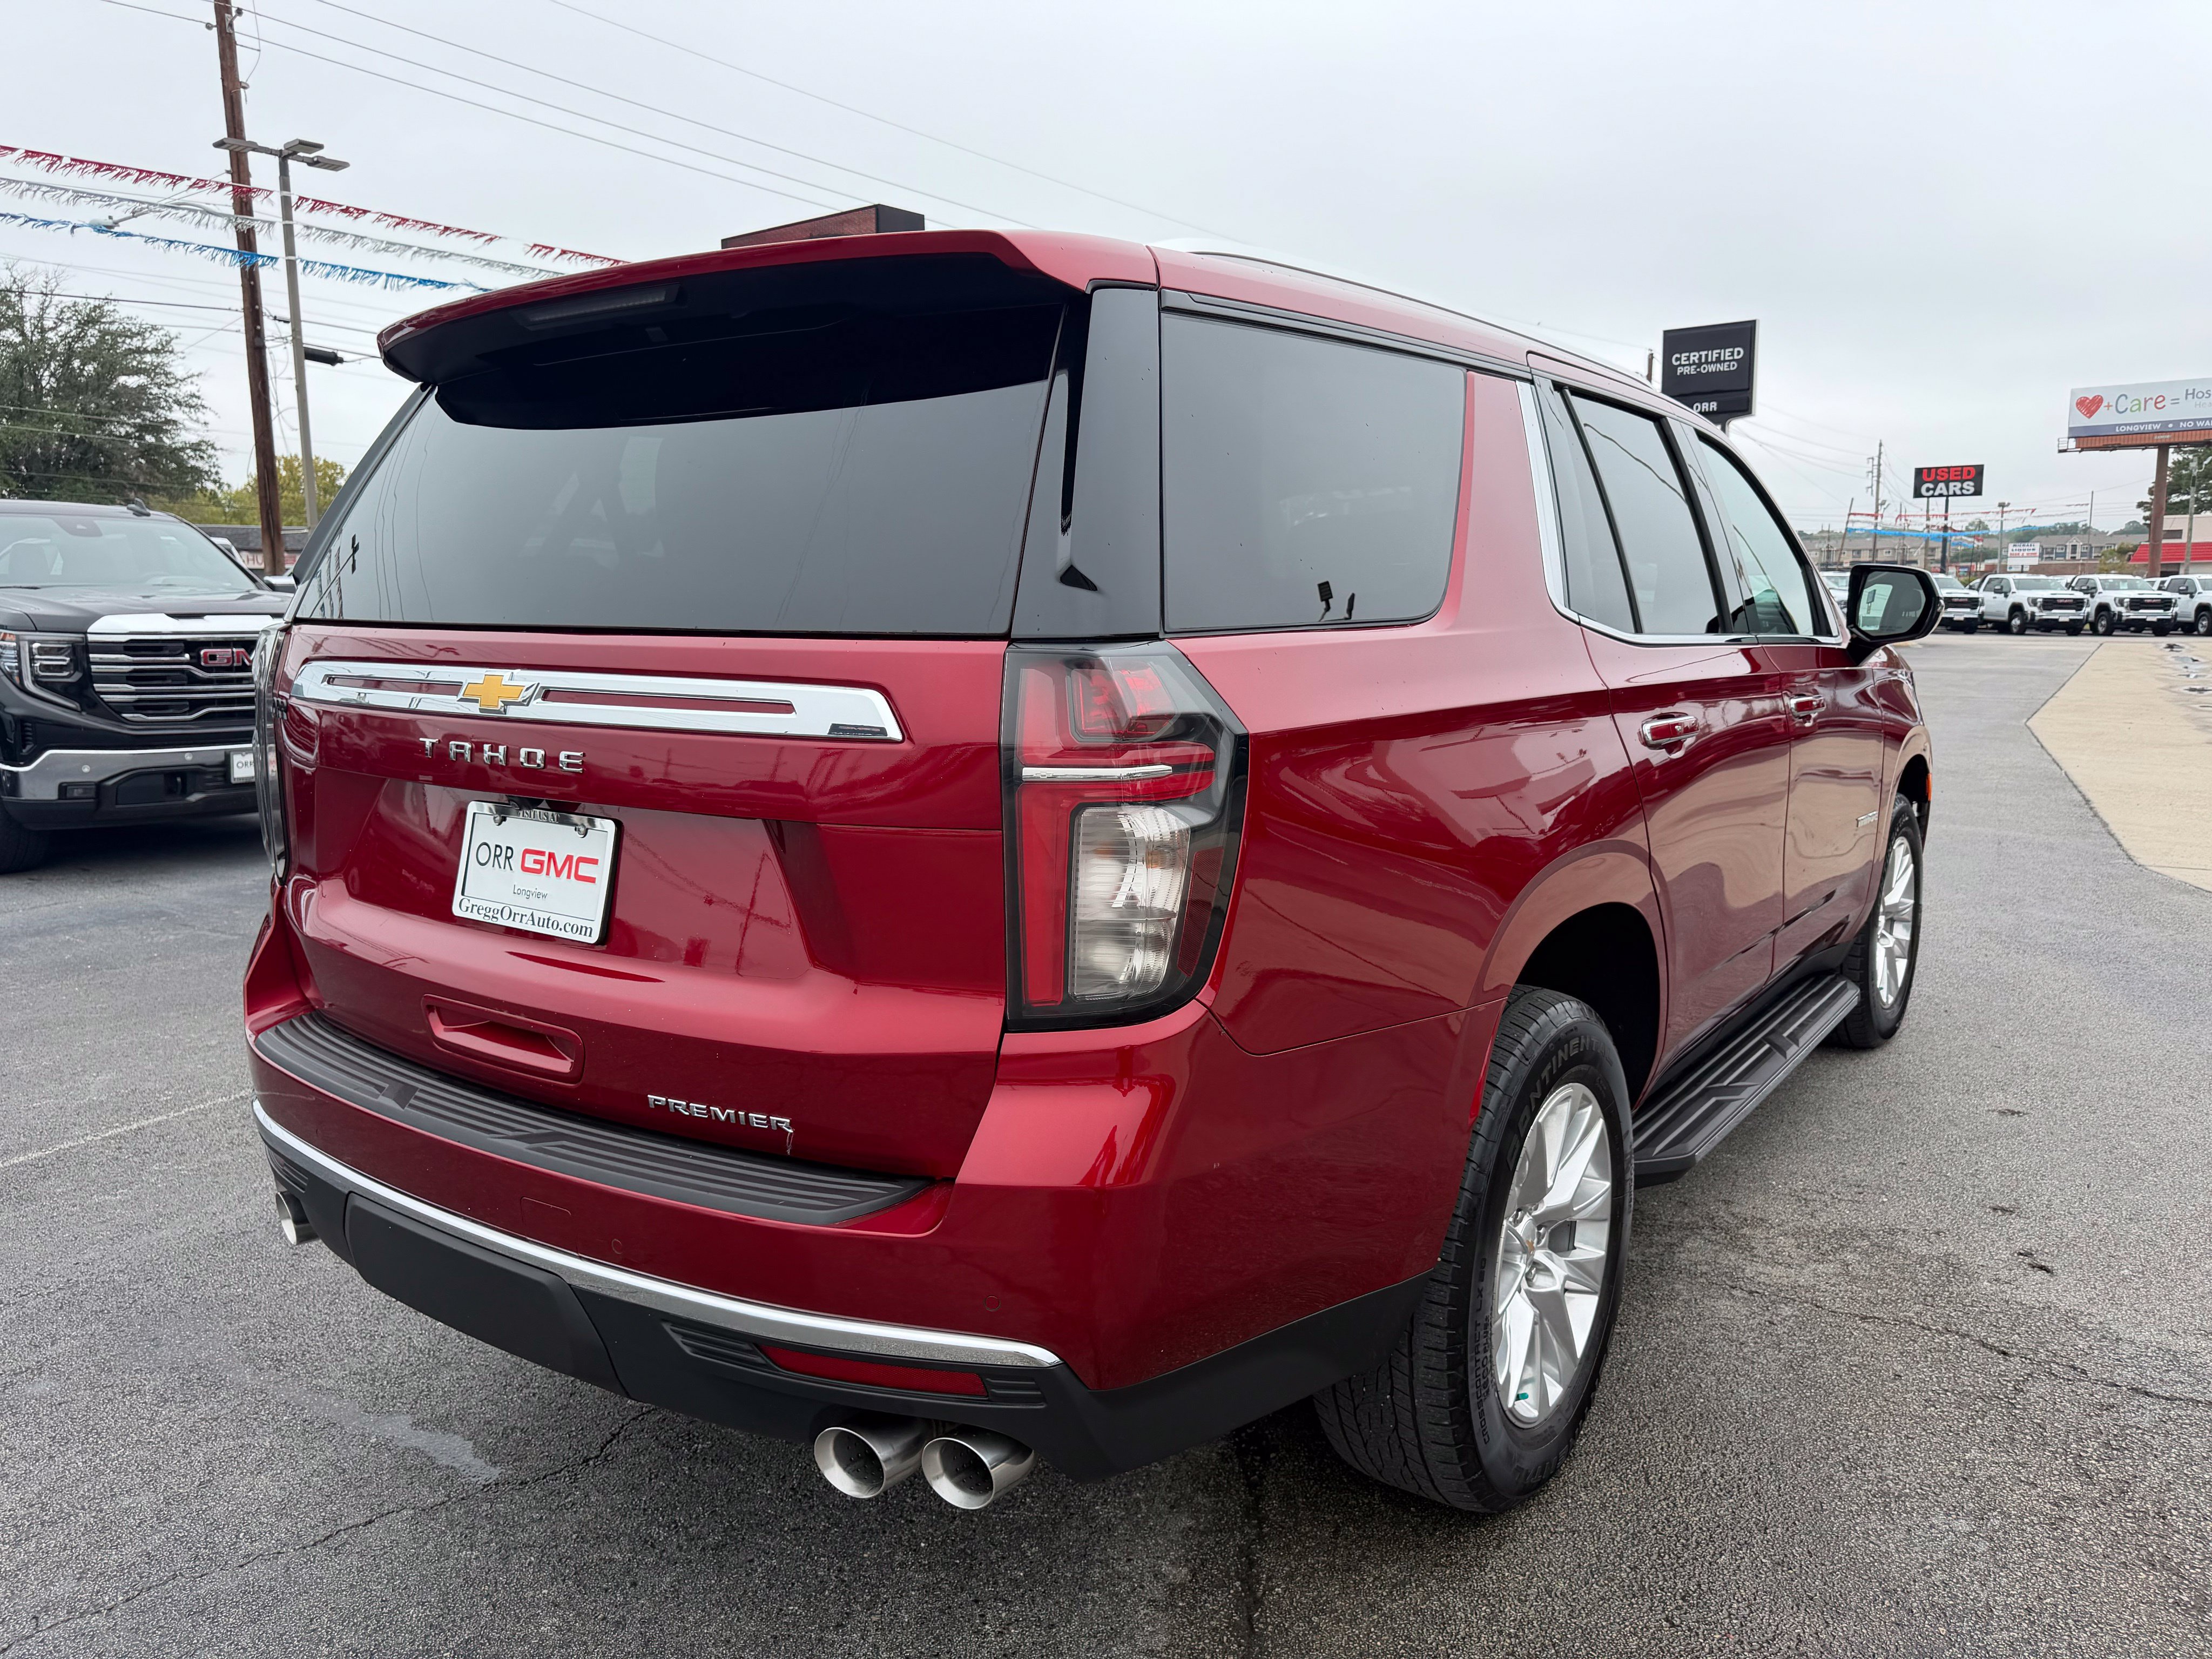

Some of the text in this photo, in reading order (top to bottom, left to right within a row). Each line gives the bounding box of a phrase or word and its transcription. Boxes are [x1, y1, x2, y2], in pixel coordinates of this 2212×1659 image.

[1671, 347, 1744, 365] CERTIFIED
[1677, 361, 1737, 375] PRE-OWNED
[1693, 401, 1717, 413] ORR
[2115, 394, 2167, 414] Care
[2116, 423, 2161, 432] LONGVIEW
[1923, 467, 1975, 482] USED
[1921, 481, 1975, 496] CARS
[419, 737, 584, 773] TAHOE
[518, 810, 560, 824] VISIT US AT
[476, 841, 599, 884] ORR GMC
[513, 885, 548, 900] Longview
[458, 898, 594, 938] GreggOrrAuto.com
[648, 1094, 794, 1133] PREMIER
